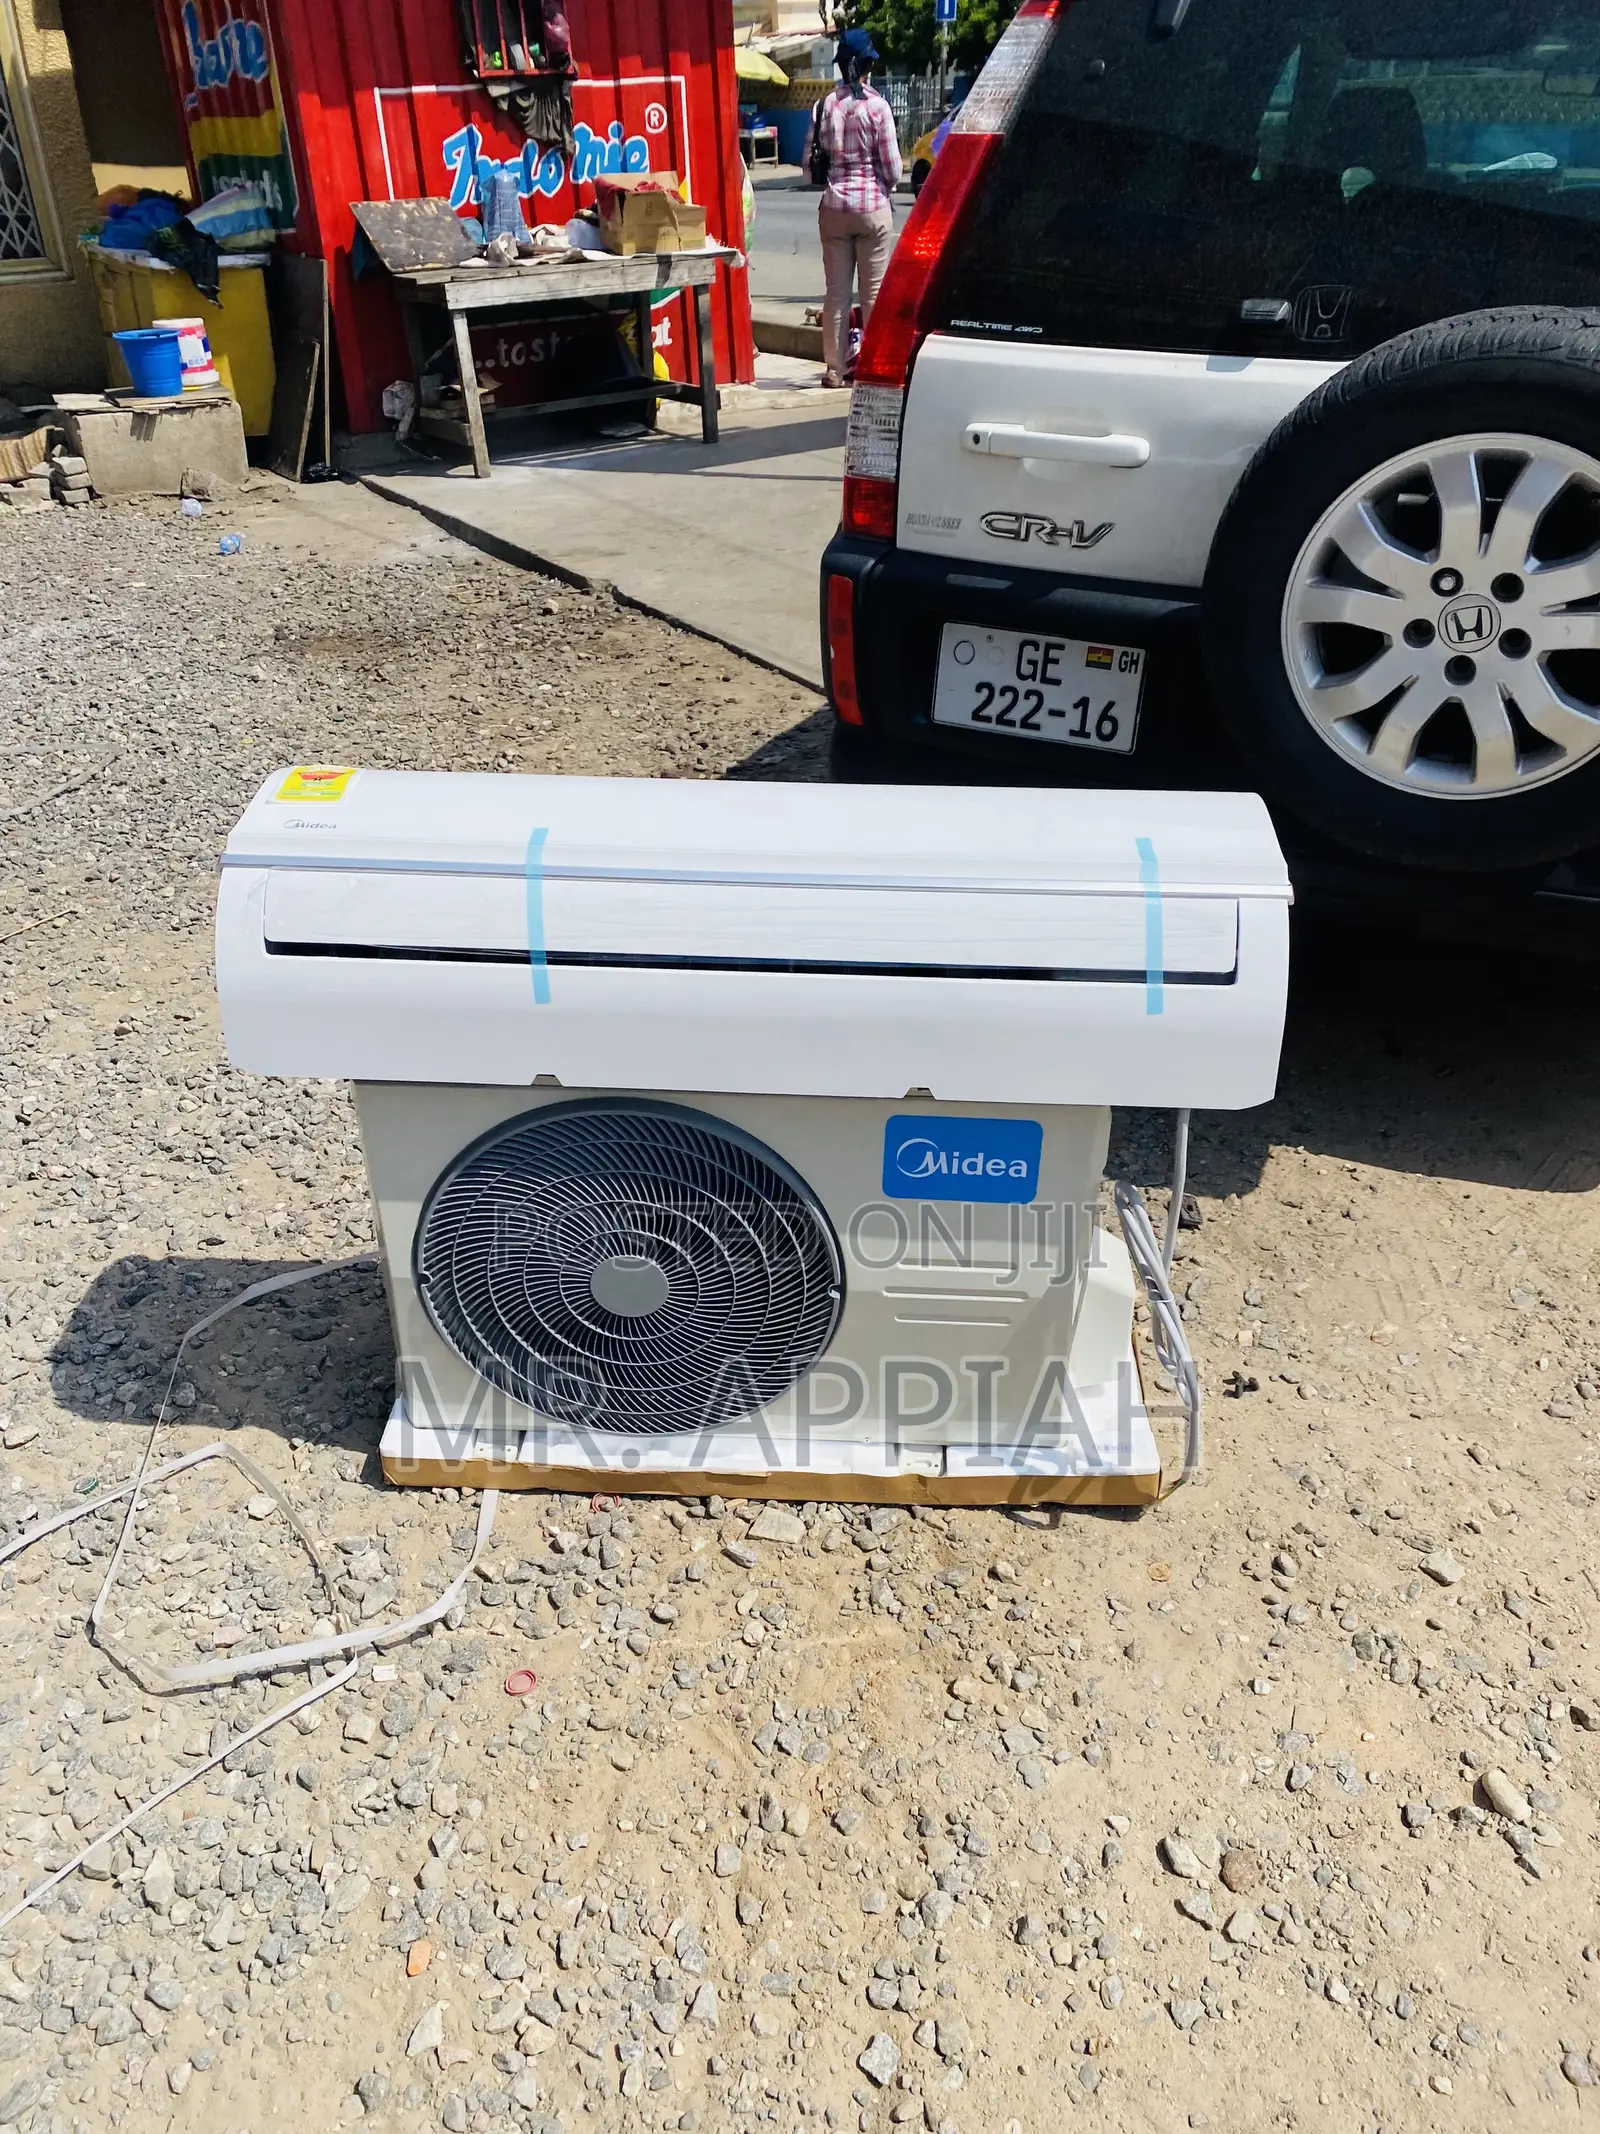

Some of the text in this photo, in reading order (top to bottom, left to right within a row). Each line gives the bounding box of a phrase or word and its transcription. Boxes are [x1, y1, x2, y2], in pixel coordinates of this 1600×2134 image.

[950, 319, 1013, 331] REALTIME
[979, 511, 1116, 549] CR-V
[1015, 639, 1141, 686] GE GH
[971, 681, 1119, 742] 222-16
[284, 819, 337, 829] Midea
[897, 1139, 1028, 1178] Midea
